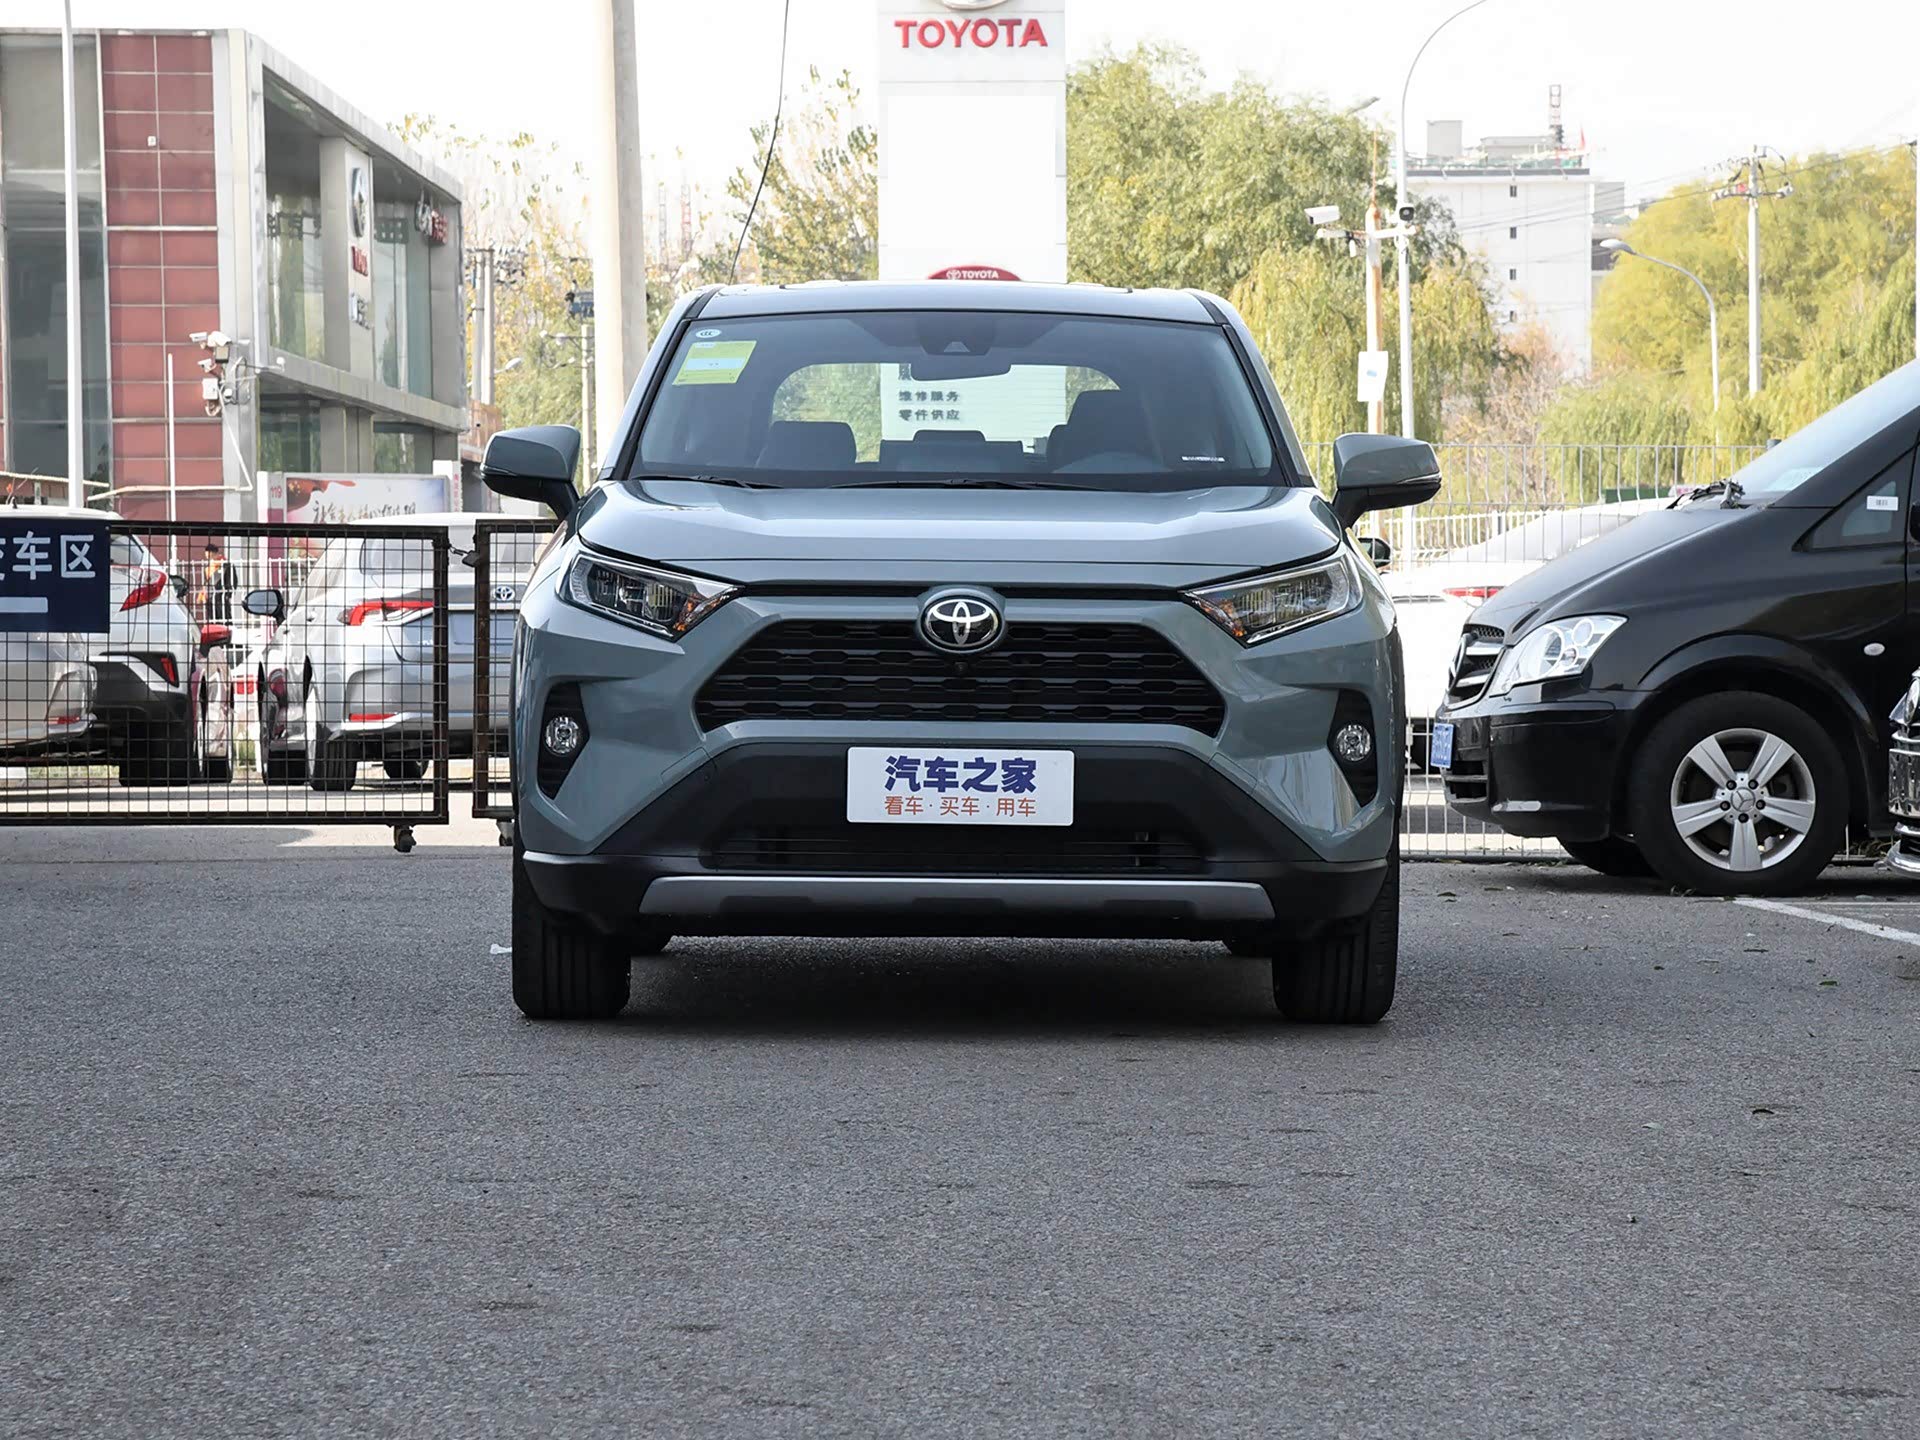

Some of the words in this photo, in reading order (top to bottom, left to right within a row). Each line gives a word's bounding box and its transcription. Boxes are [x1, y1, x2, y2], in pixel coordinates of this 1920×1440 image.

[894, 18, 1048, 48] TOYOTA
[963, 270, 999, 279] TOYOTA
[899, 390, 959, 402] 维修服务
[899, 409, 960, 421] 零件供应
[0, 530, 97, 580] 车区
[884, 755, 1037, 794] 汽车之家
